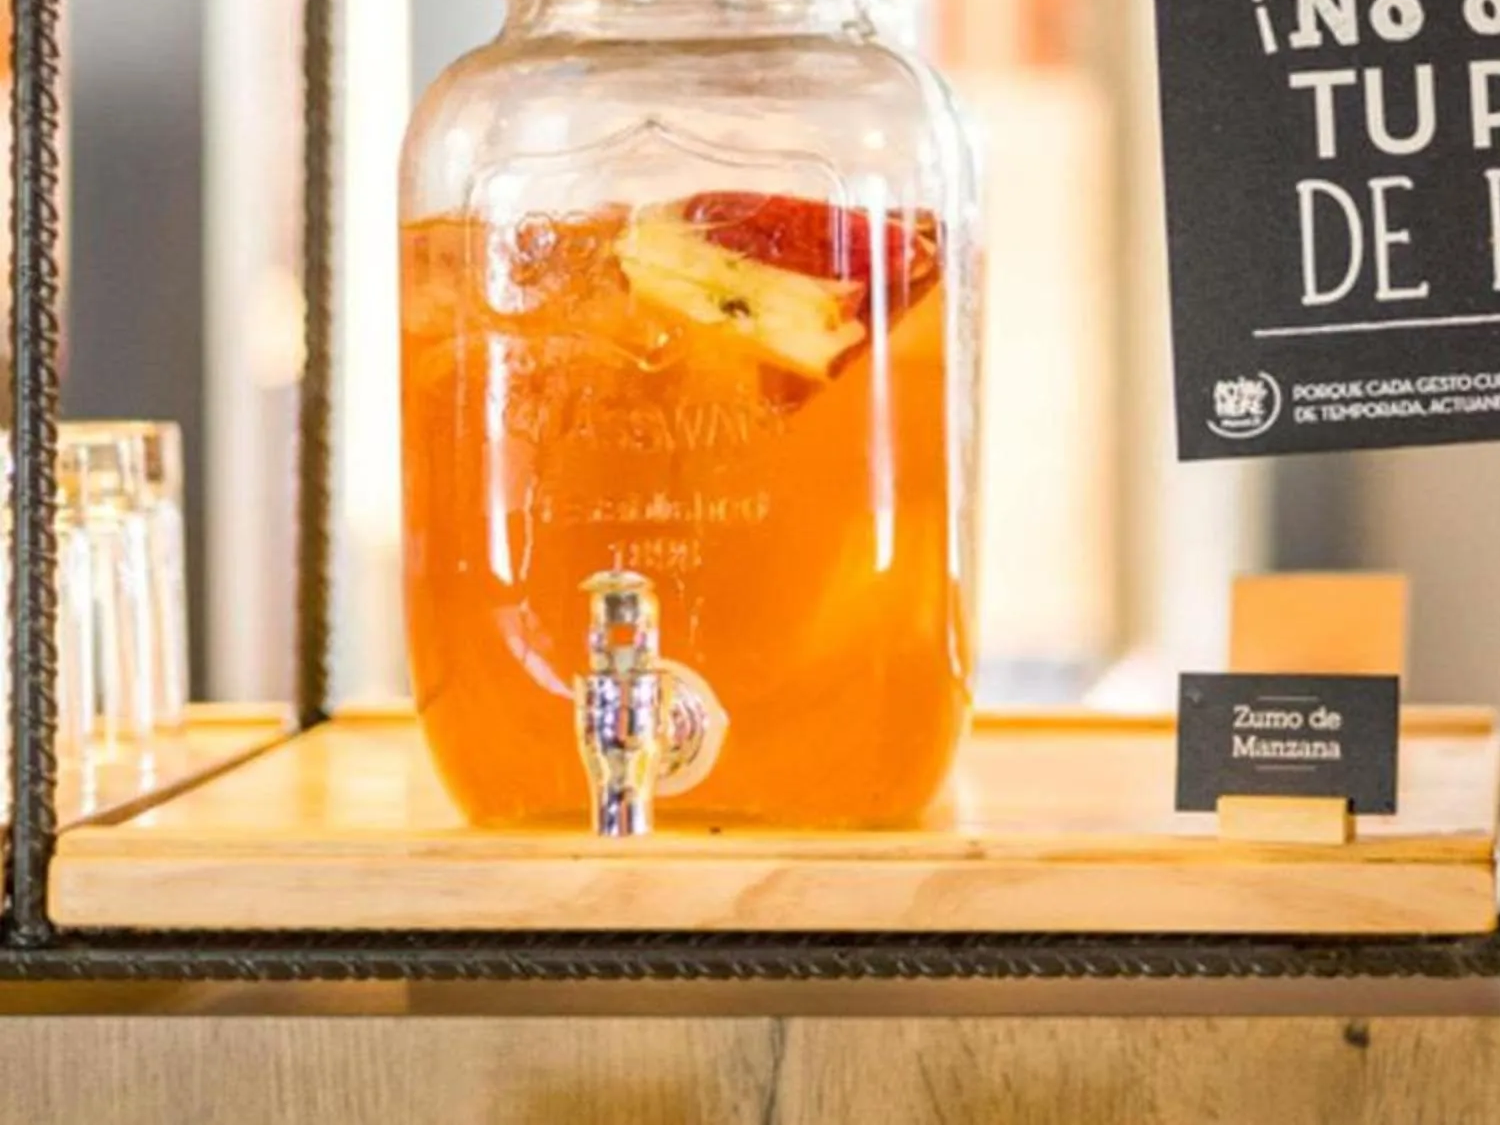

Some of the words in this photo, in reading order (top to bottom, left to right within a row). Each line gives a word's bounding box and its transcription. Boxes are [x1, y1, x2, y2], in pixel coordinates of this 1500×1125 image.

[1288, 62, 1437, 160] TU
[1296, 176, 1430, 306] DE
[1292, 382, 1363, 401] PORQUE
[1365, 378, 1415, 396] CADA
[1415, 375, 1472, 393] GESTO
[1293, 405, 1319, 424] DE
[1232, 705, 1304, 729] Zumo
[1308, 706, 1342, 730] de
[1231, 734, 1342, 760] Manzana
